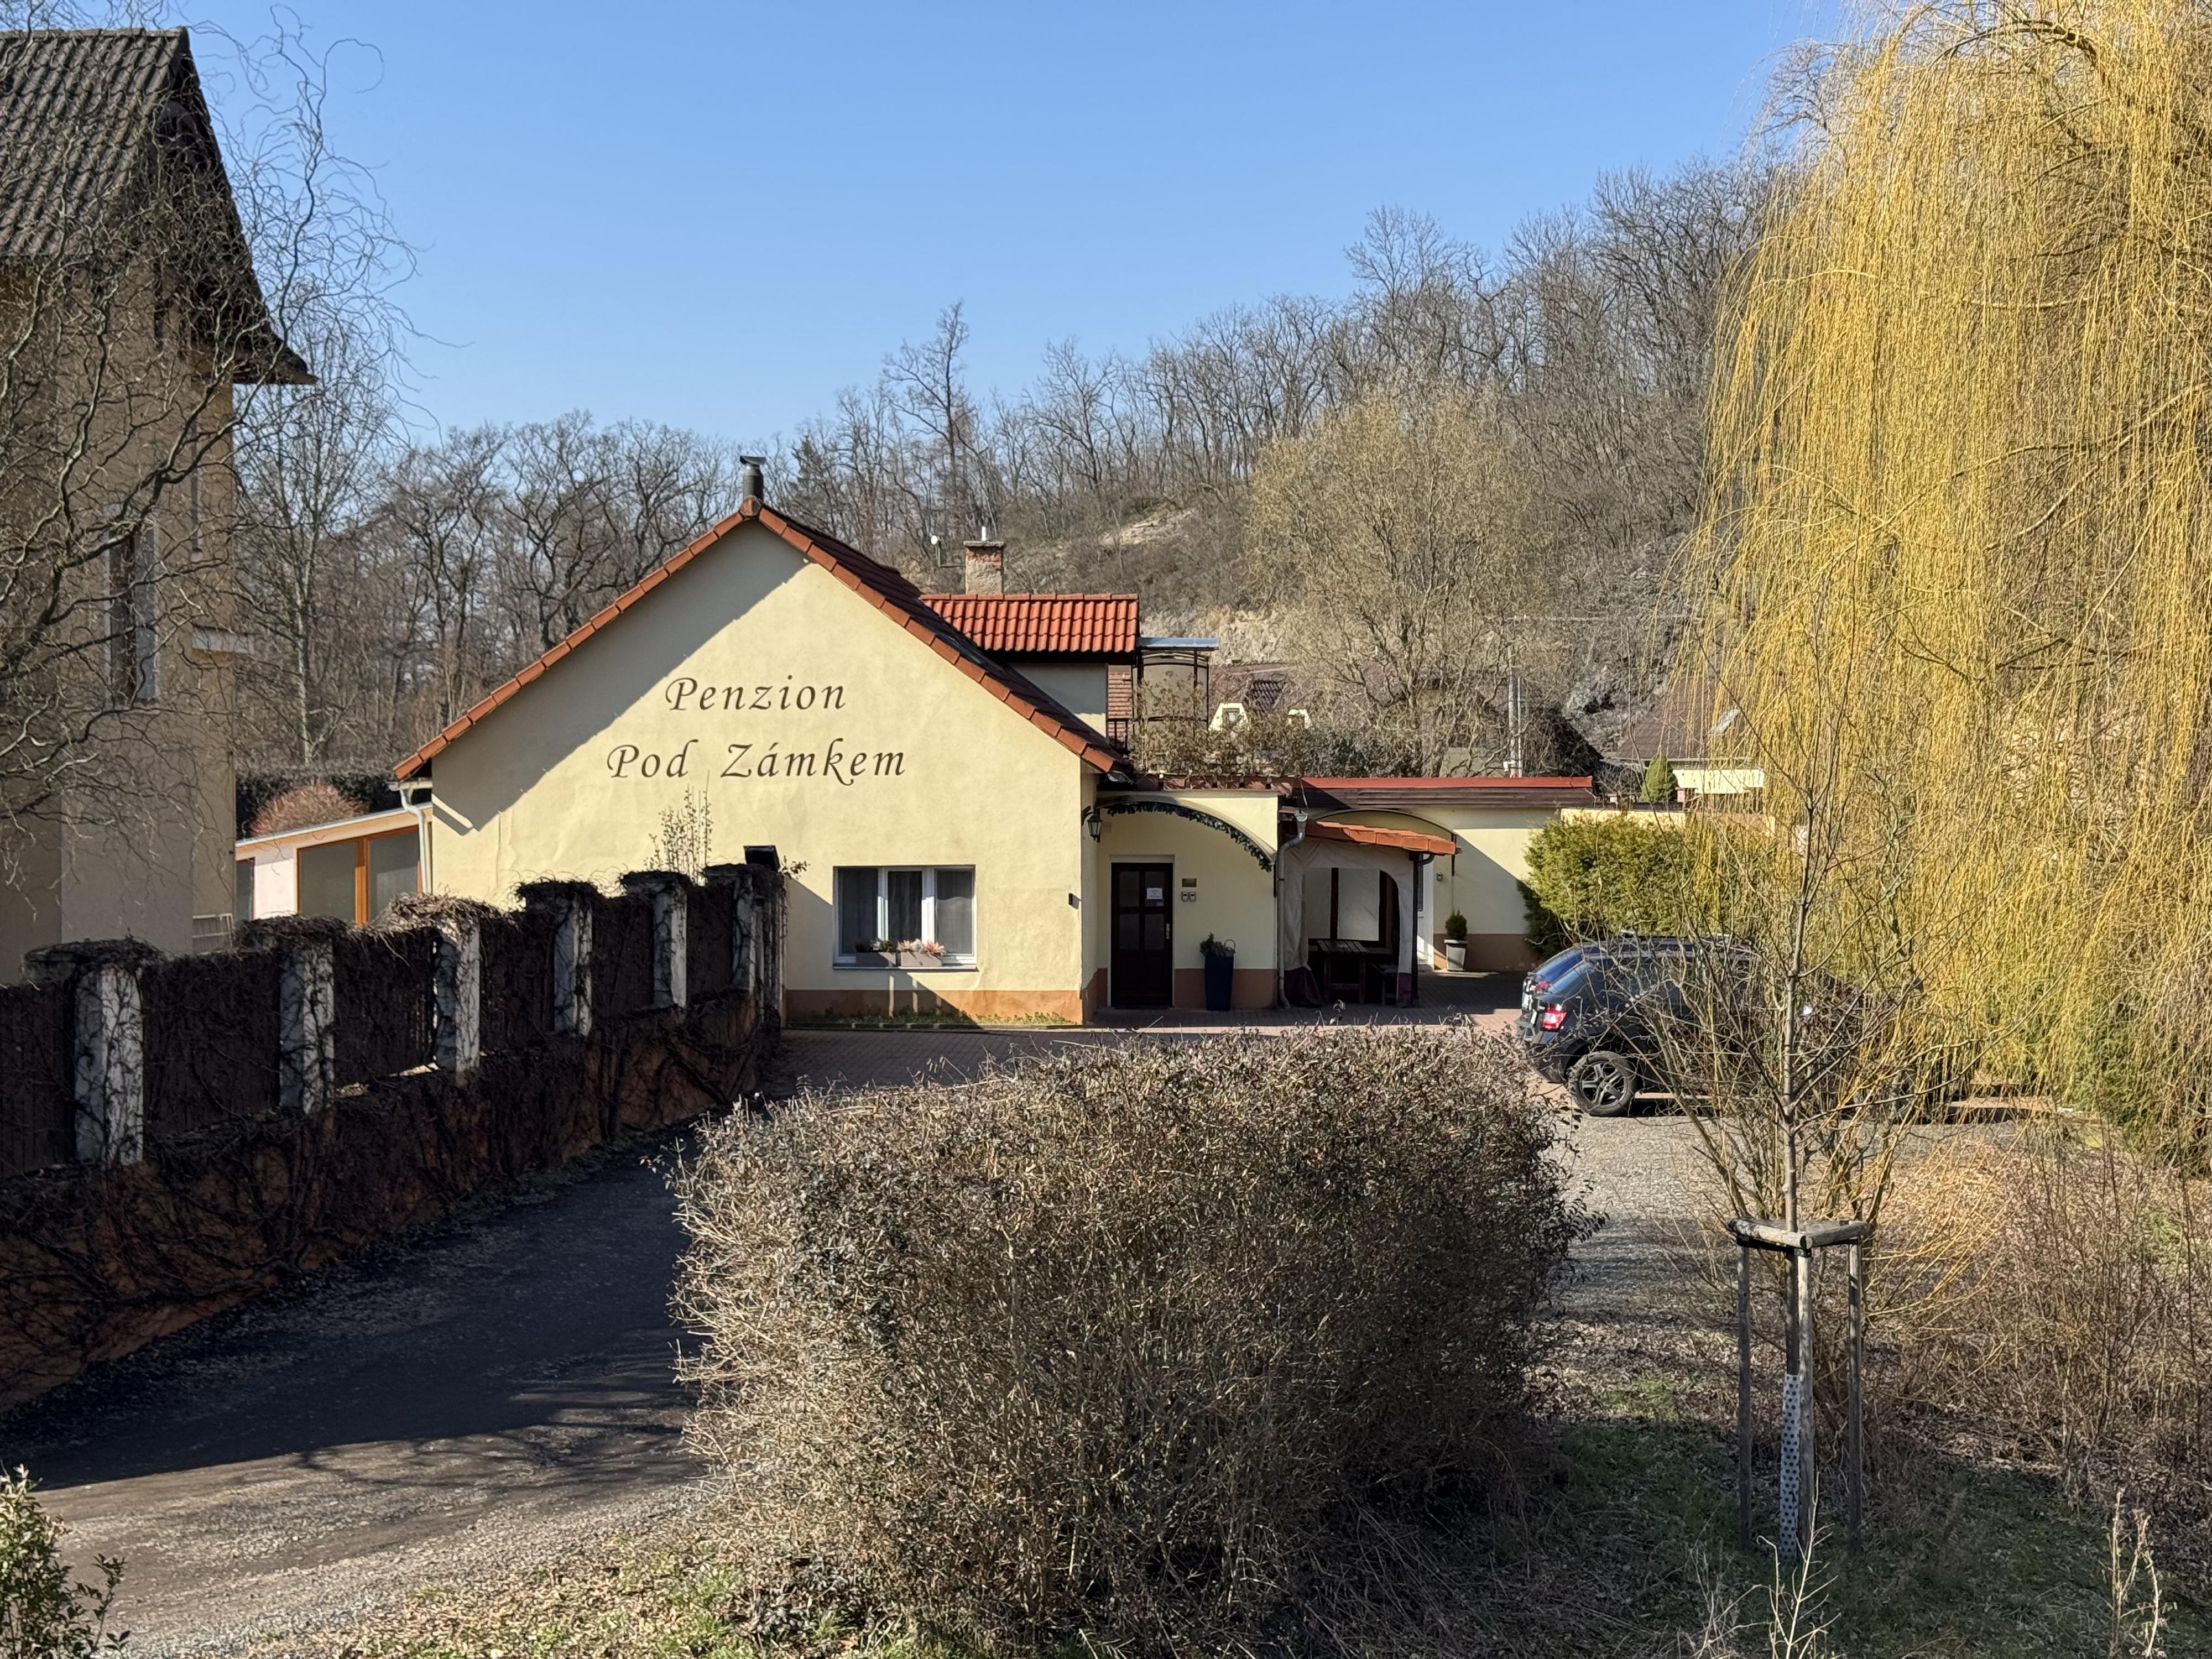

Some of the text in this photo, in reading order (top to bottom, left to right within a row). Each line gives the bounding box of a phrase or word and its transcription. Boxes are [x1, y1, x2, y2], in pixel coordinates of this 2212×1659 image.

[665, 674, 846, 711] Penzion
[607, 737, 905, 786] Pod Zámkem
